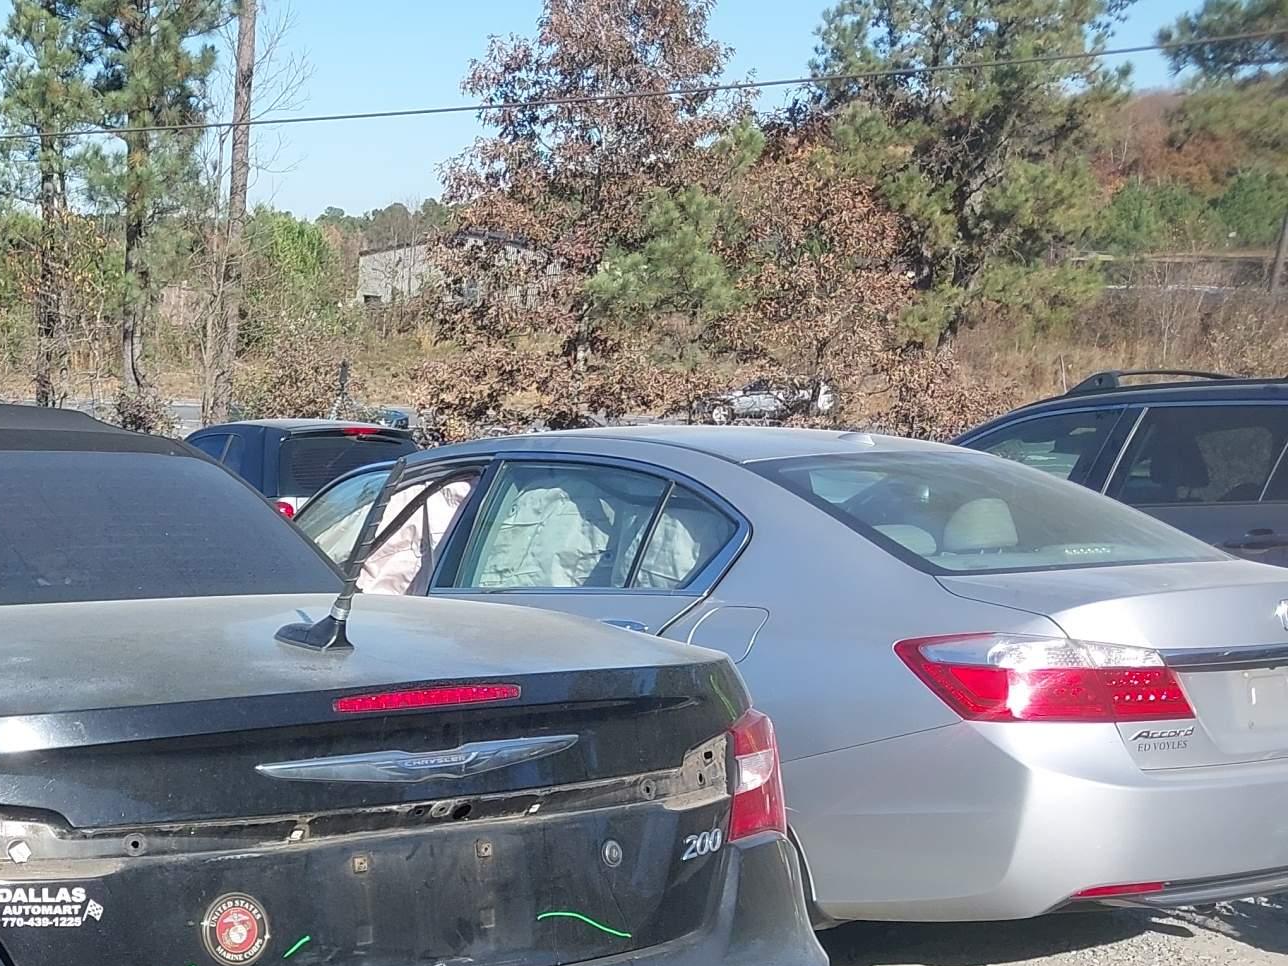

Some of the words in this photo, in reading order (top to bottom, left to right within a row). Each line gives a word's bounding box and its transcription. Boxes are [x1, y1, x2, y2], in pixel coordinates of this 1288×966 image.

[1130, 726, 1195, 741] Accord
[1137, 743, 1151, 752] ED
[1153, 740, 1187, 750] VOYLES
[682, 828, 722, 861] 200
[2, 905, 82, 916] AUTOMART
[210, 901, 233, 928] UNITED
[234, 900, 262, 920] STATES
[2, 916, 82, 928] 770-439-1225
[215, 945, 244, 960] MARINE
[244, 938, 263, 959] CORPS
